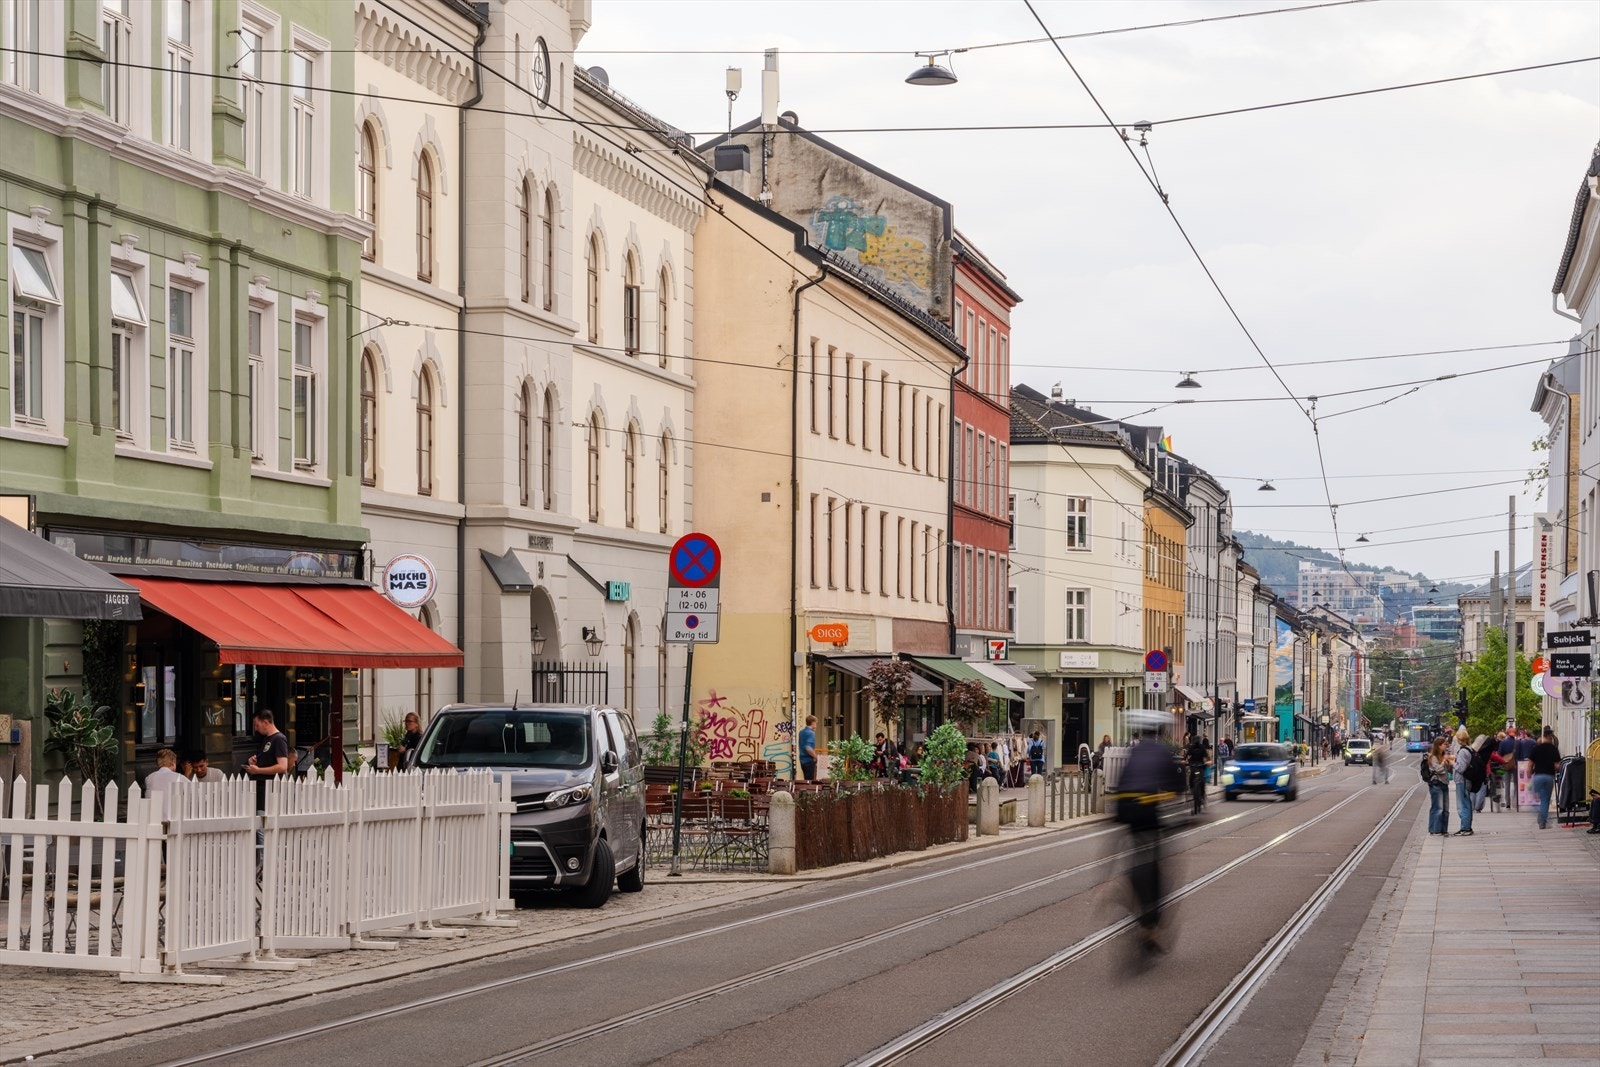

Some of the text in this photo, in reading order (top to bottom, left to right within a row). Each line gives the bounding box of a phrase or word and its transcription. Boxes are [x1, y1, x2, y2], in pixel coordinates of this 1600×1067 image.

[389, 572, 427, 581] MUCHO
[390, 581, 427, 590] MAS
[681, 590, 689, 598] 14
[695, 590, 707, 598] 06
[105, 593, 130, 605] JAGGER
[679, 601, 707, 610] (12-06)
[675, 631, 709, 641] Øvrig tid
[1553, 635, 1585, 644] Subjekt
[991, 642, 1004, 660] 7
